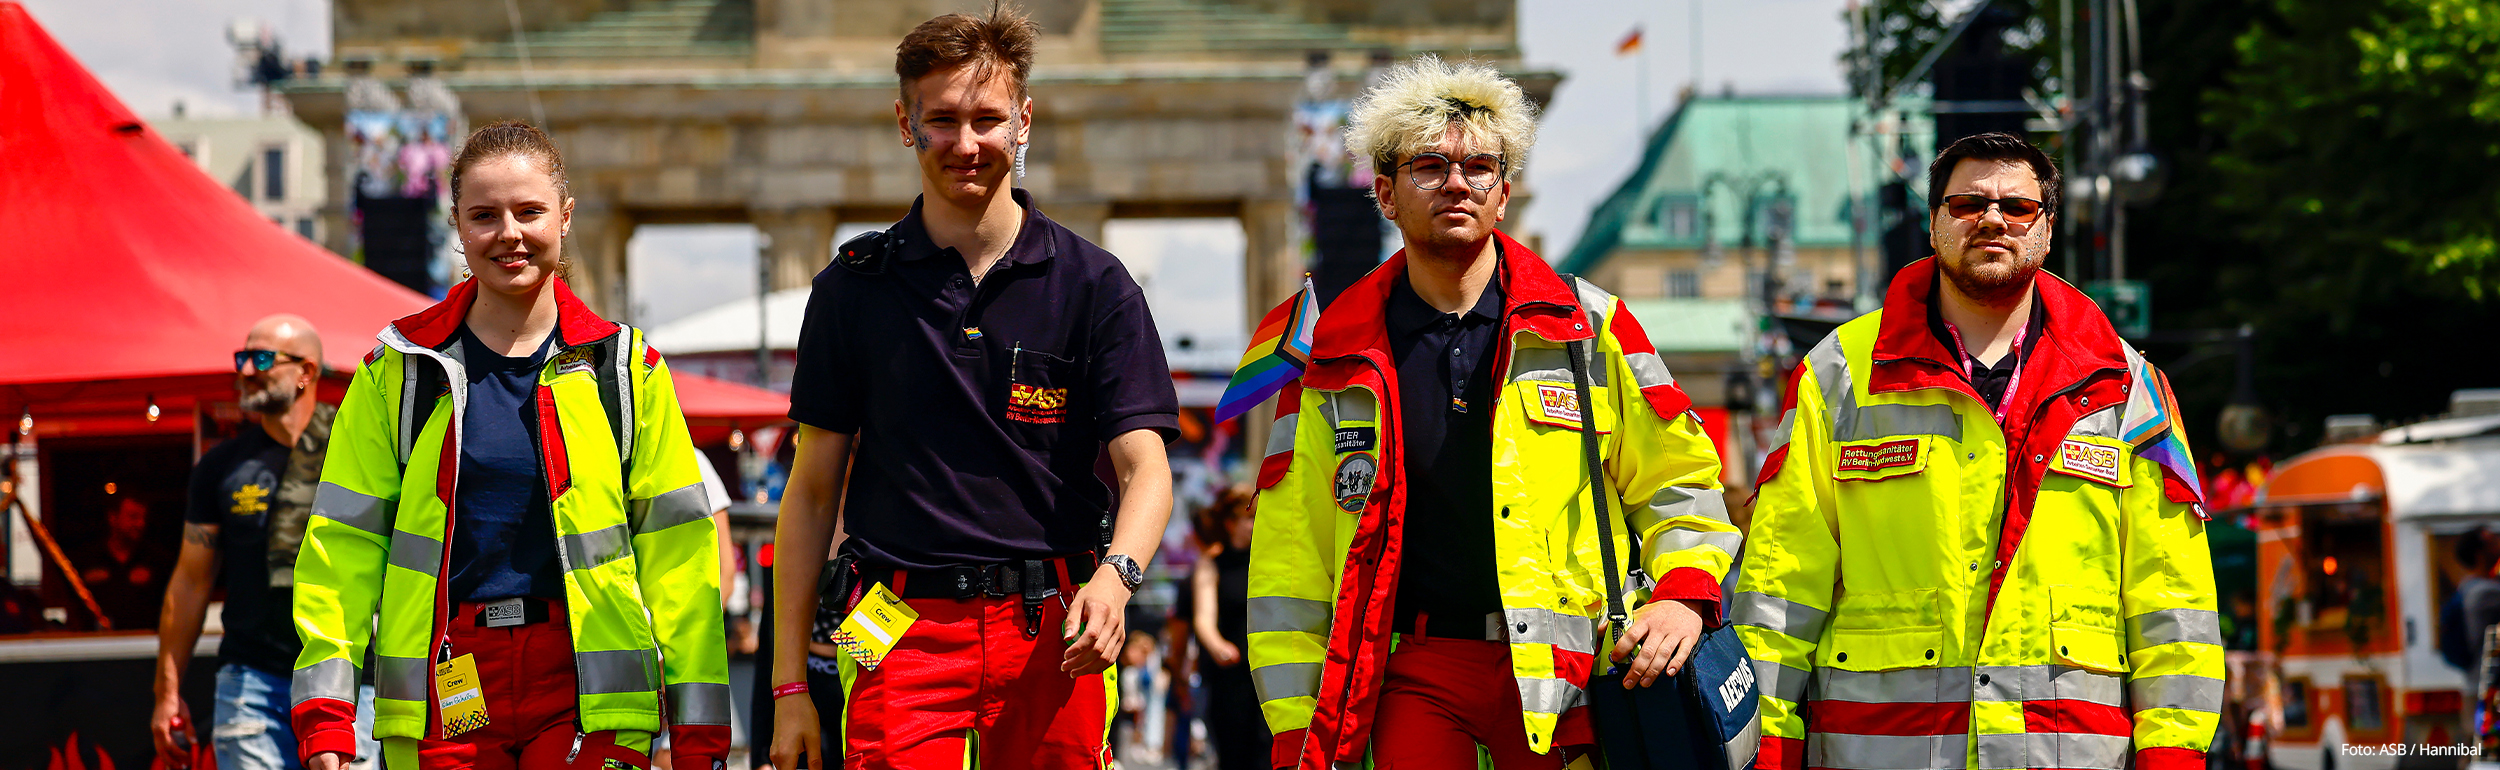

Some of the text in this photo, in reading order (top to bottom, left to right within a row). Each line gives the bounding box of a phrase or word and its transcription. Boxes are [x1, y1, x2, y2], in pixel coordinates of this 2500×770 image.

[1025, 386, 1068, 409] ASB
[2078, 446, 2116, 468] ASB
[497, 603, 522, 616] ASB
[875, 608, 892, 623] Crew
[447, 678, 463, 687] Crew
